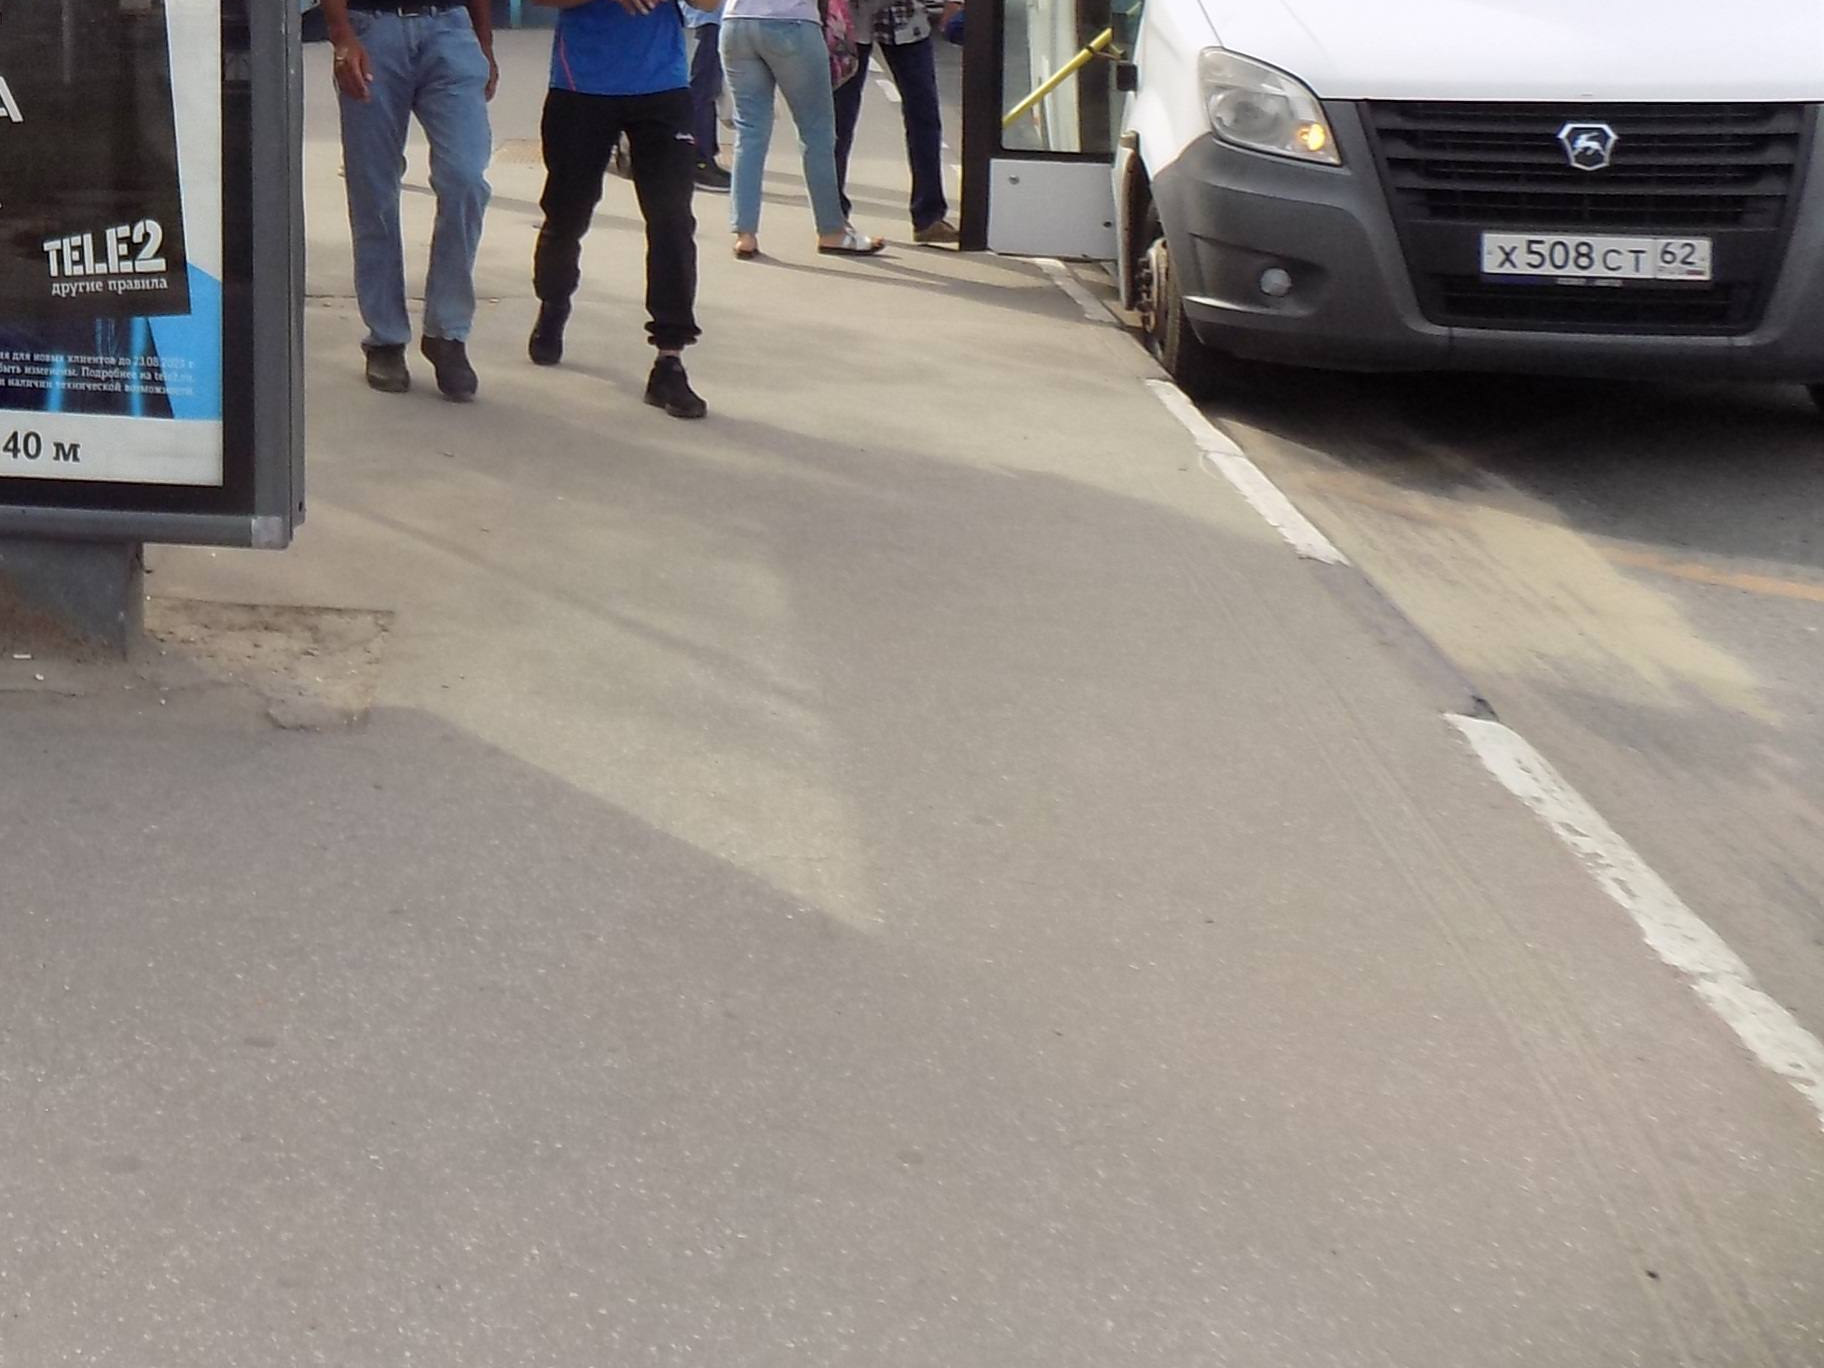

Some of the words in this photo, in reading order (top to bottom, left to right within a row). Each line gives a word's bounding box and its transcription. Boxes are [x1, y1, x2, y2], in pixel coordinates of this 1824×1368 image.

[43, 219, 168, 278] TELE2
[1659, 241, 1696, 266] 62
[51, 278, 104, 297] другие
[108, 276, 169, 294] правила
[2, 430, 42, 460] 40
[52, 439, 81, 463] м
